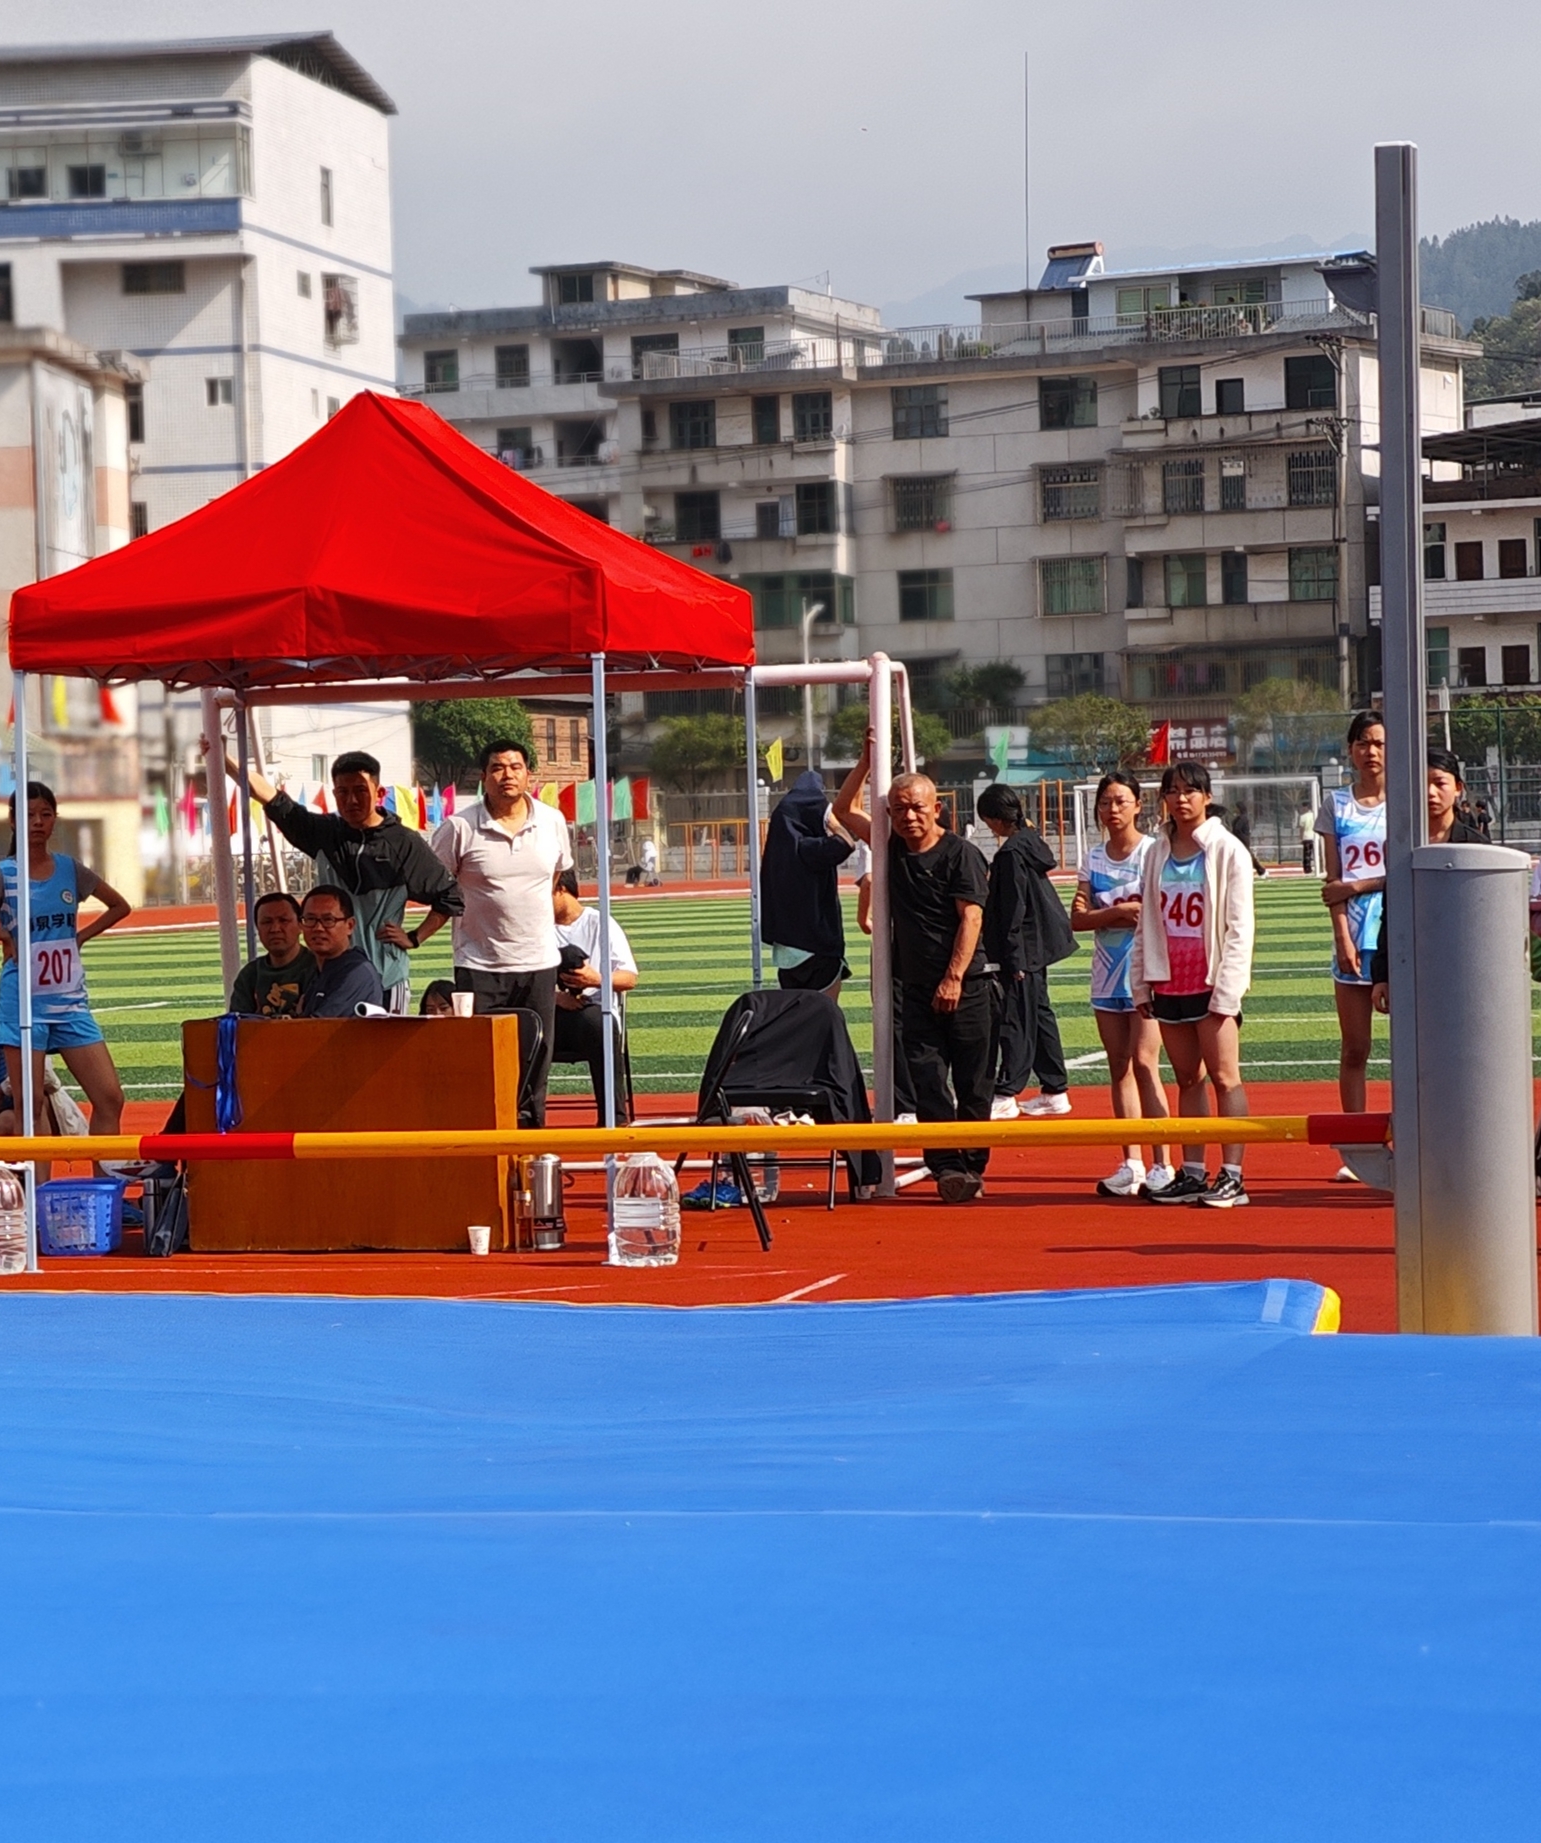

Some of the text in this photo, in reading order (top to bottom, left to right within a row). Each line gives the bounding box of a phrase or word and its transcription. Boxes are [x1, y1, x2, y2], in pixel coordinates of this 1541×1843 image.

[1146, 725, 1227, 750] 精品店
[1345, 841, 1385, 872] 26
[30, 912, 75, 932] 泉学
[37, 948, 73, 986] 207
